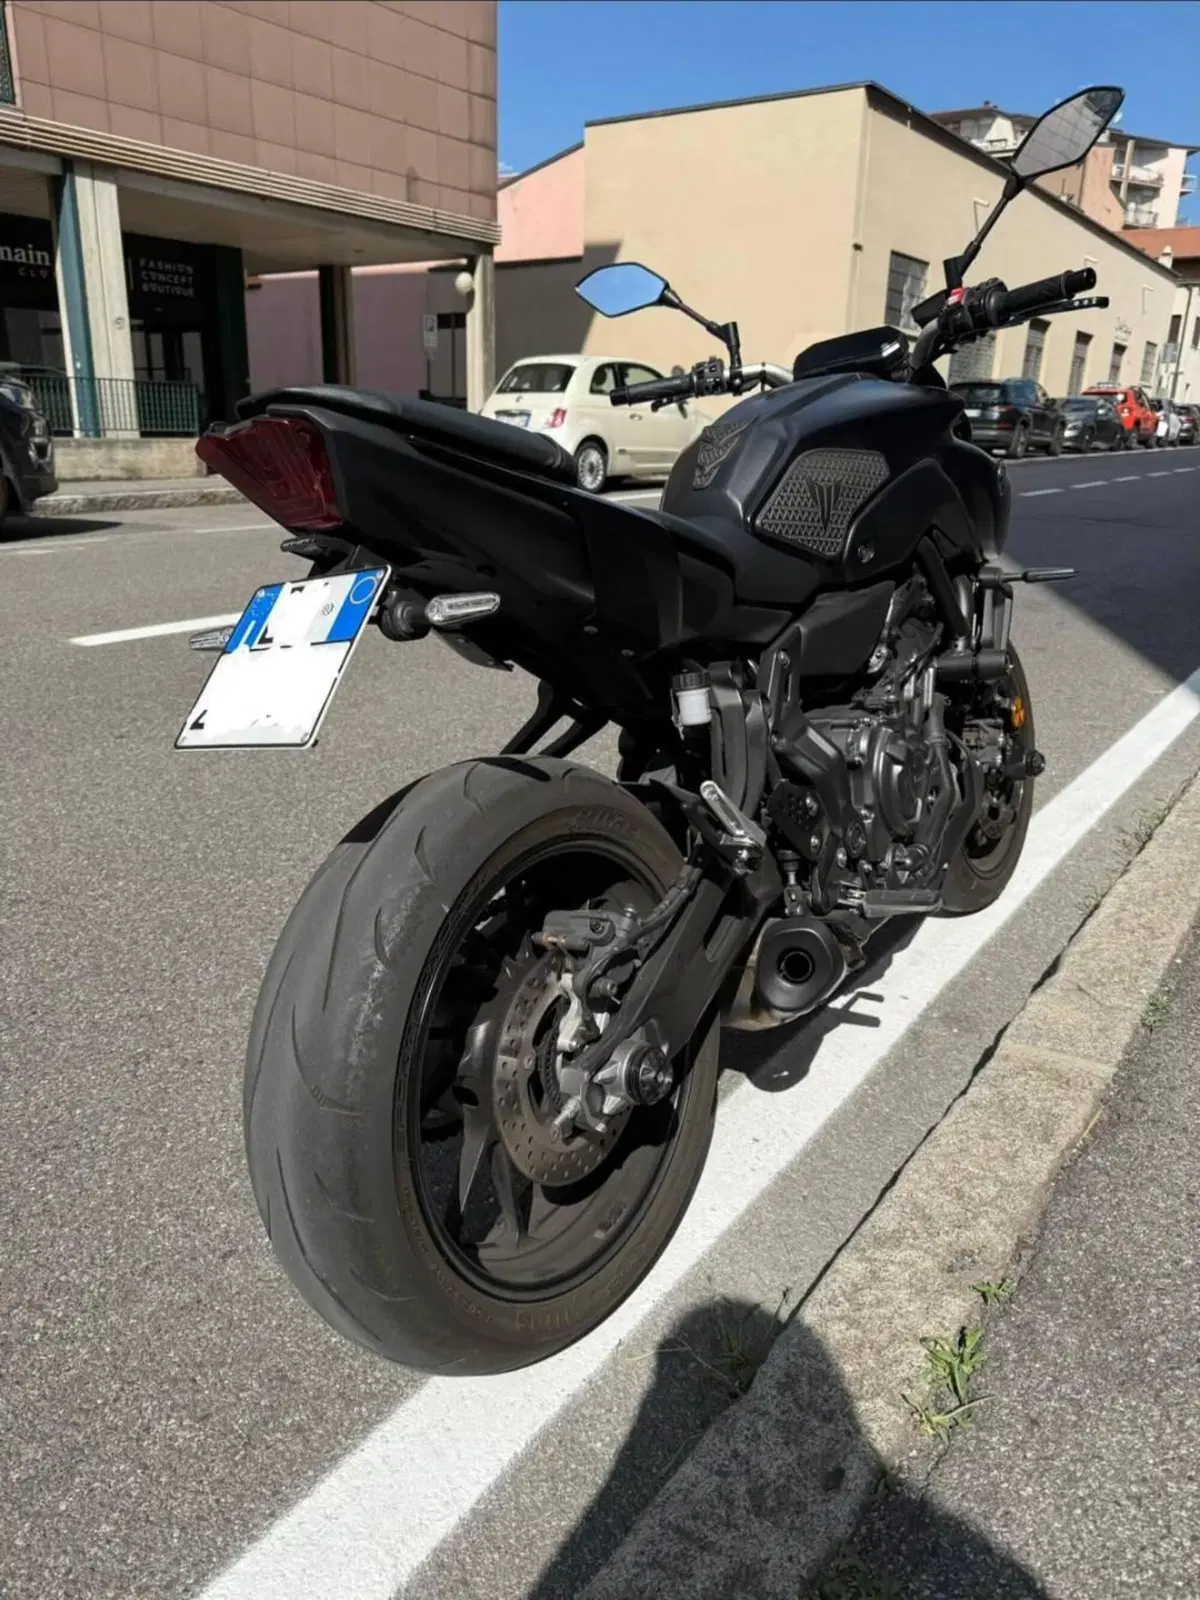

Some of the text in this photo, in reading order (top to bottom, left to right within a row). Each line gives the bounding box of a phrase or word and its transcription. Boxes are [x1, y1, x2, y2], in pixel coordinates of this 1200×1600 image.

[139, 257, 194, 274] FASHION
[140, 270, 194, 284] CONCEPT
[142, 282, 195, 298] BOUTIQUE
